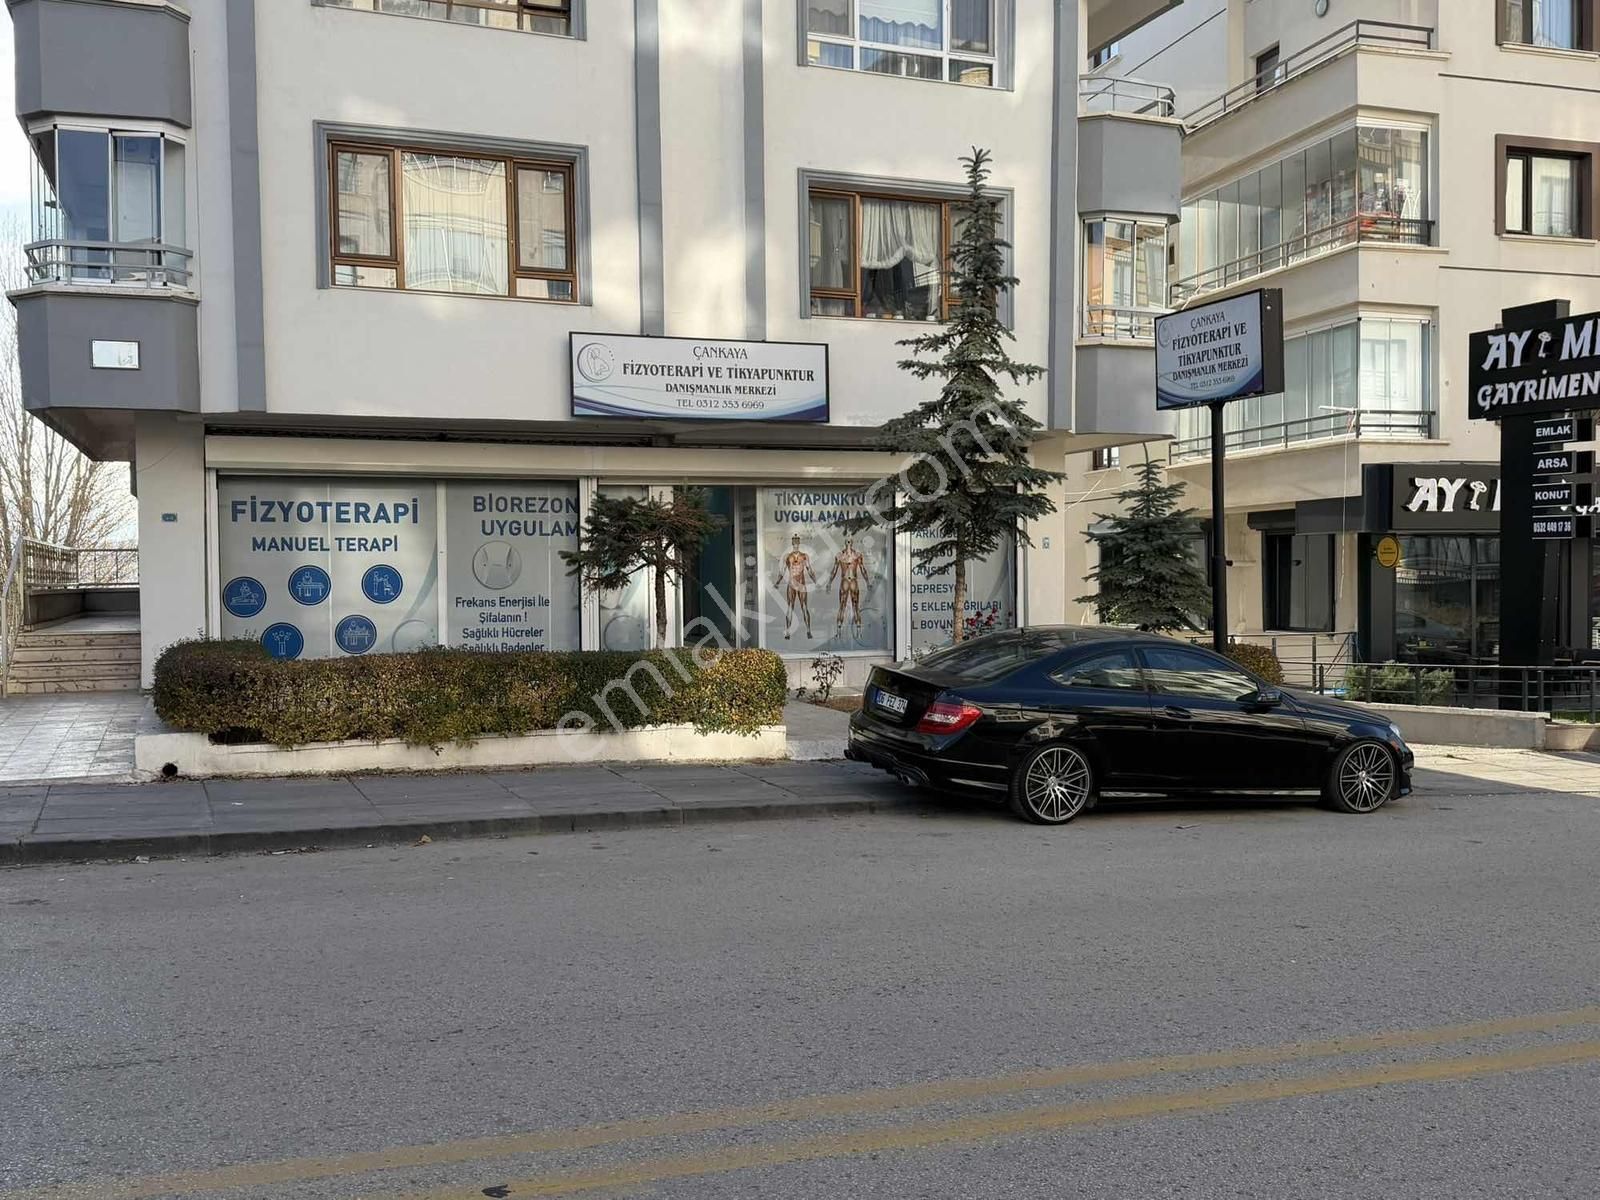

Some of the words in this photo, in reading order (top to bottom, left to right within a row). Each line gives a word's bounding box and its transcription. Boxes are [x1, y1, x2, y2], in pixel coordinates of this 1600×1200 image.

[1191, 311, 1226, 331] ÇANKAYA
[1172, 322, 1231, 351] FİZYOTERAPİ
[1234, 322, 1247, 337] VE
[1481, 329, 1533, 371] AY
[1559, 318, 1600, 361] M
[693, 345, 748, 360] ÇANKAYA
[1178, 343, 1241, 367] TİKYAPUNKTUR
[622, 360, 704, 379] FİZYOTERAPİ
[708, 366, 723, 379] VE
[726, 364, 815, 382] TİKYAPUNKTUR
[665, 382, 732, 396] DANIŞMANLIK
[734, 383, 777, 397] MERKEZİ
[676, 399, 694, 408] TEL
[696, 399, 720, 409] 0312
[722, 400, 740, 409] 353
[741, 401, 765, 410] 6969
[1535, 425, 1571, 437] EMLAK
[1537, 457, 1568, 469] ARSA
[775, 490, 866, 506] TİKYAPUNKTU
[1406, 477, 1467, 512] AY
[1535, 490, 1570, 501] KONUT
[231, 495, 418, 524] FİZYOTERAPİ
[252, 537, 330, 552] MANUEL
[335, 535, 398, 552] TERAPİ
[455, 597, 497, 608] Frekans
[499, 596, 536, 610] Enerjisi
[479, 611, 522, 625] Şifalanın
[462, 627, 499, 641] Sağlıklı
[501, 626, 544, 638] Hücreler
